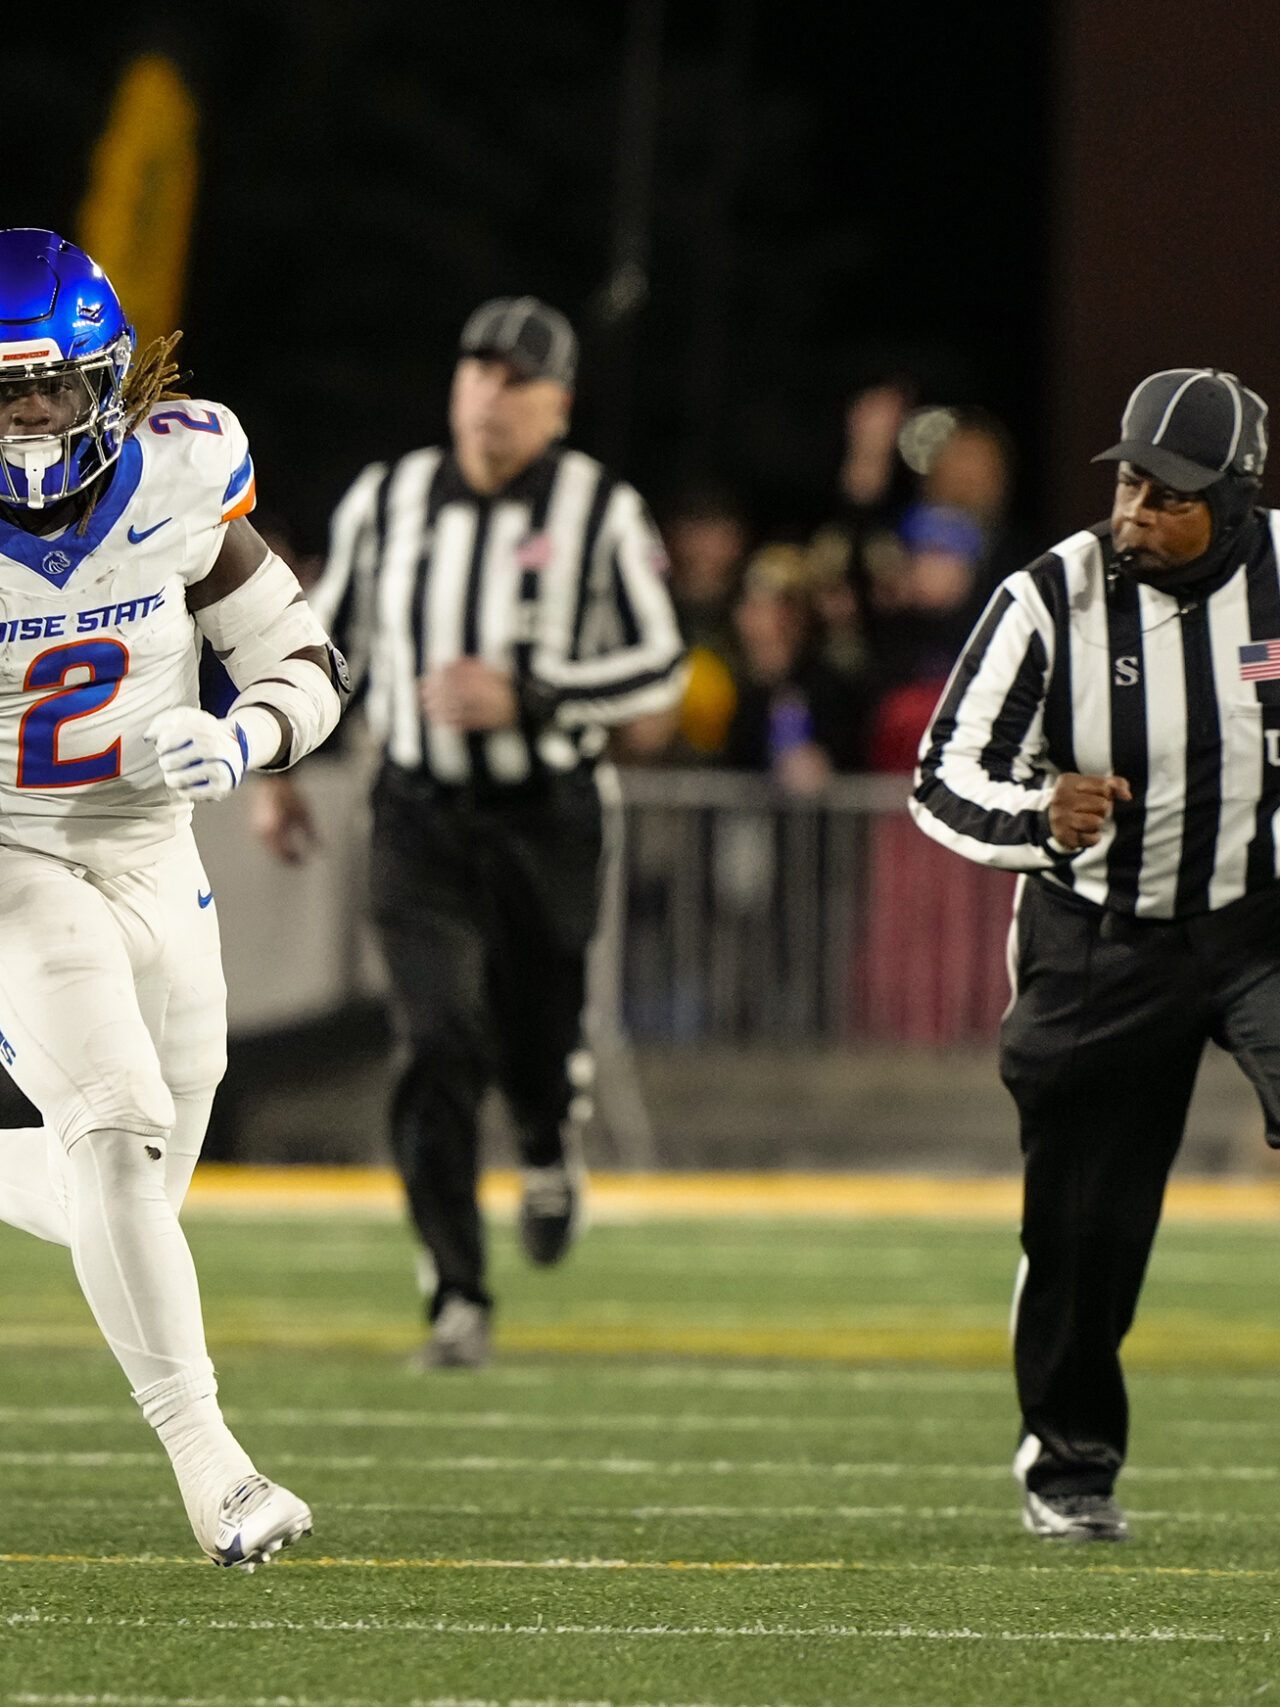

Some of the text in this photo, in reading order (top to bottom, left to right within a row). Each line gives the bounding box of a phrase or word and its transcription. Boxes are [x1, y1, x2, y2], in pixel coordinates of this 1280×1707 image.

[148, 409, 224, 436] 2
[76, 586, 166, 634] STATE
[1114, 656, 1140, 686] S
[16, 638, 130, 789] 2
